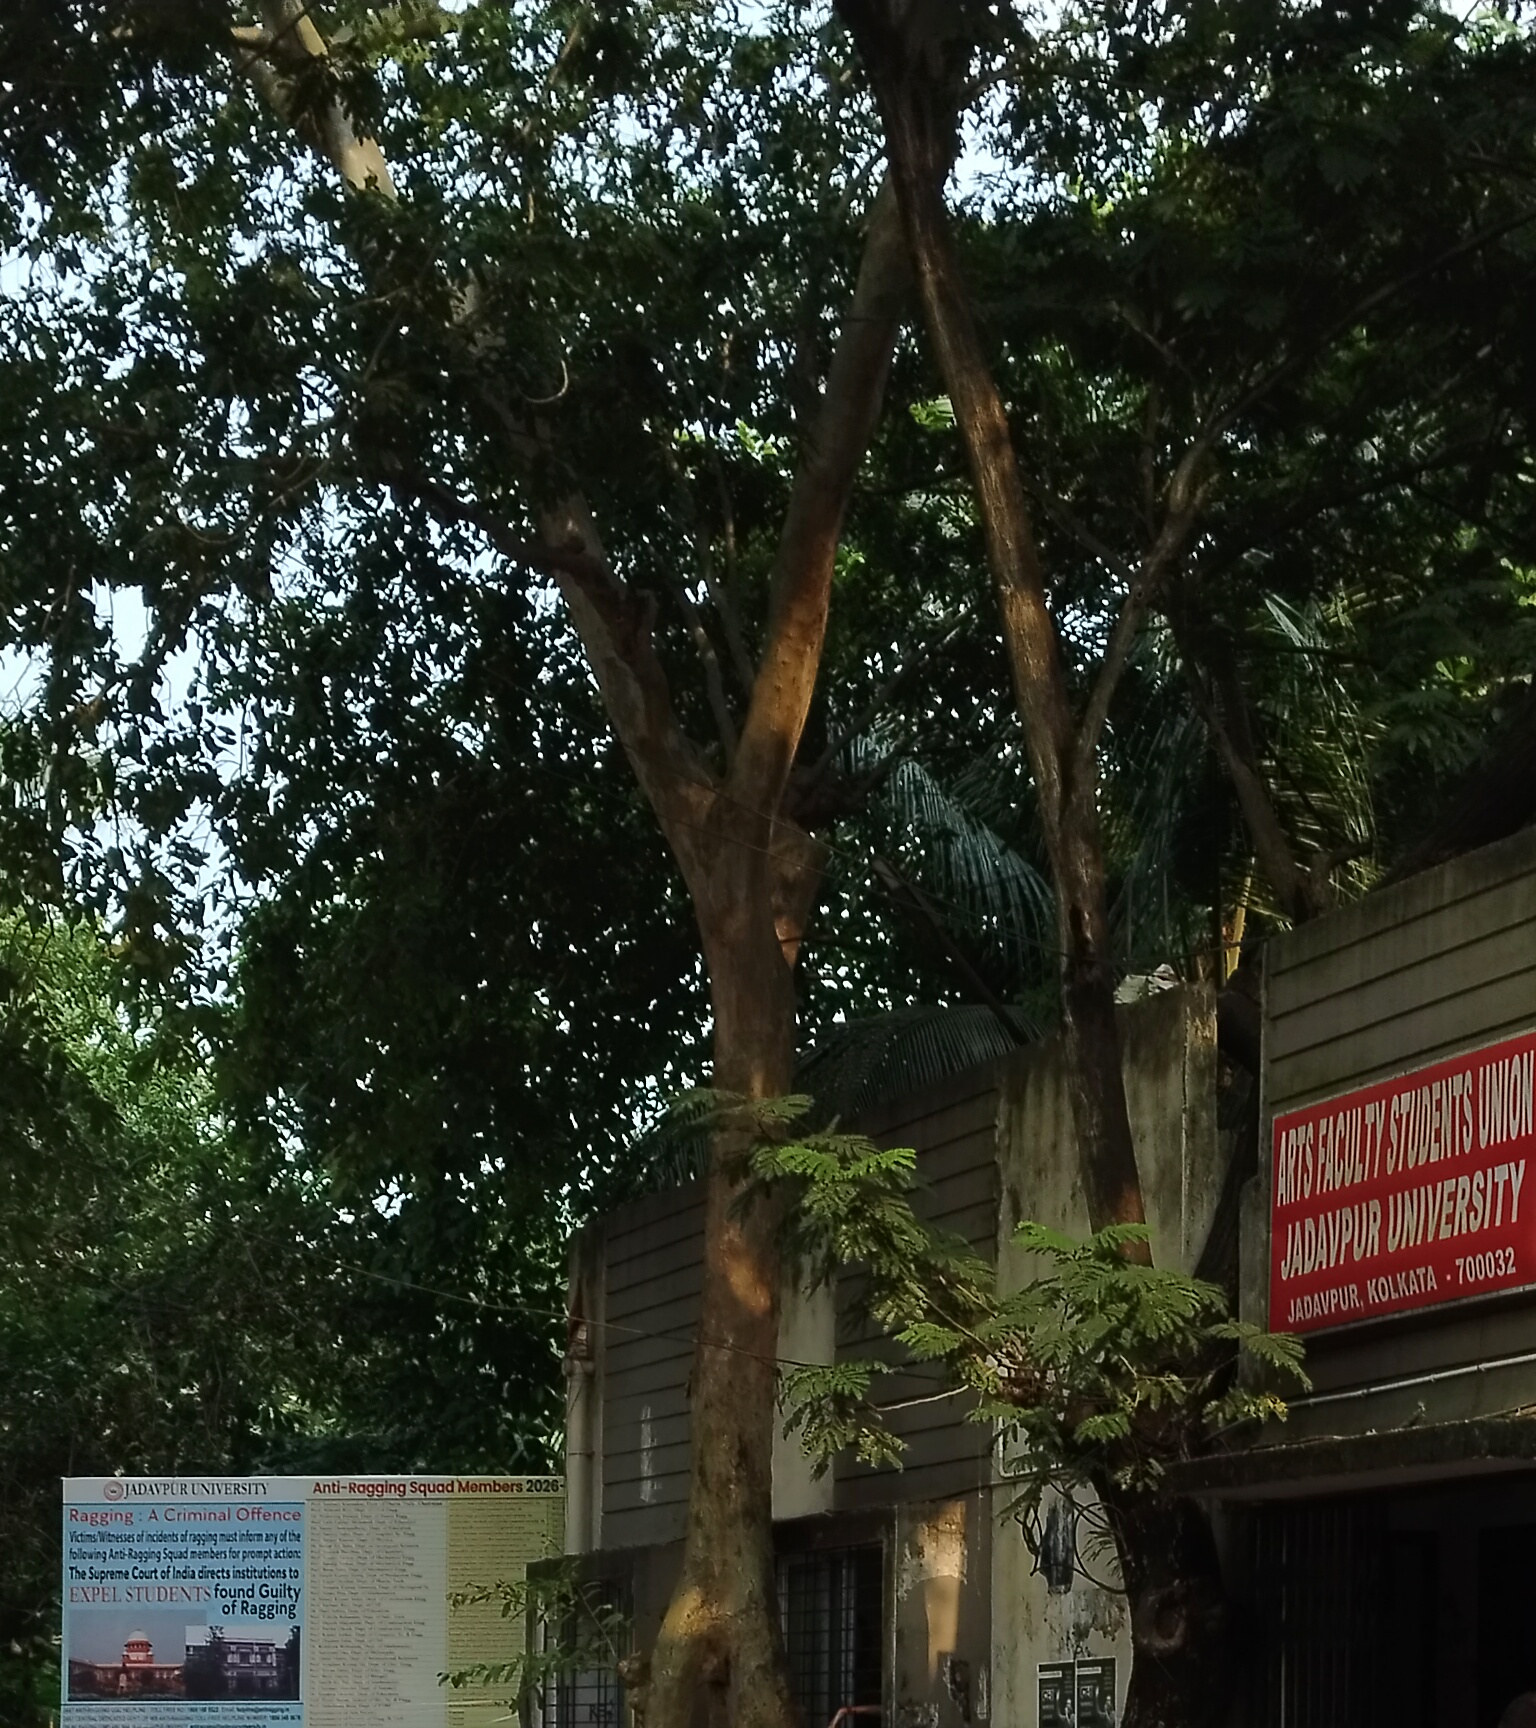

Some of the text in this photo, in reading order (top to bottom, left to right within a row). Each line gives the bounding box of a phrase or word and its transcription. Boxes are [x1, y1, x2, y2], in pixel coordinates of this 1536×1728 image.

[1277, 1050, 1535, 1207] ARTS FACULTY STUDENTS UNION
[1281, 1160, 1526, 1281] JADAVPUR UNIVERSITY
[1288, 1283, 1364, 1324] JADAVPUR,
[1367, 1266, 1437, 1303] KOLKATA
[1455, 1247, 1517, 1285] 700032
[124, 1482, 269, 1498] JADAVPUR UNIVERSITY
[313, 1480, 407, 1497] Anti-Ragging
[410, 1480, 455, 1497] Squad
[457, 1479, 523, 1493] Members
[69, 1509, 134, 1526] Ragging
[148, 1508, 159, 1521] A
[164, 1507, 231, 1522] Criminal
[236, 1507, 301, 1521] Offence
[69, 1530, 301, 1545] Victims/Witnesses of incidents of ragging must inform any of the
[69, 1548, 107, 1560] following
[109, 1548, 161, 1562] Anti-Ragging
[163, 1549, 189, 1562] Squad
[190, 1549, 228, 1559] members
[228, 1548, 240, 1559] for
[242, 1550, 272, 1562] prompt
[69, 1566, 299, 1584] The Supreme Court of India directs institutions to
[69, 1583, 301, 1603] EXPEL STUDENTS found Guilty
[222, 1600, 297, 1620] of Ragging
